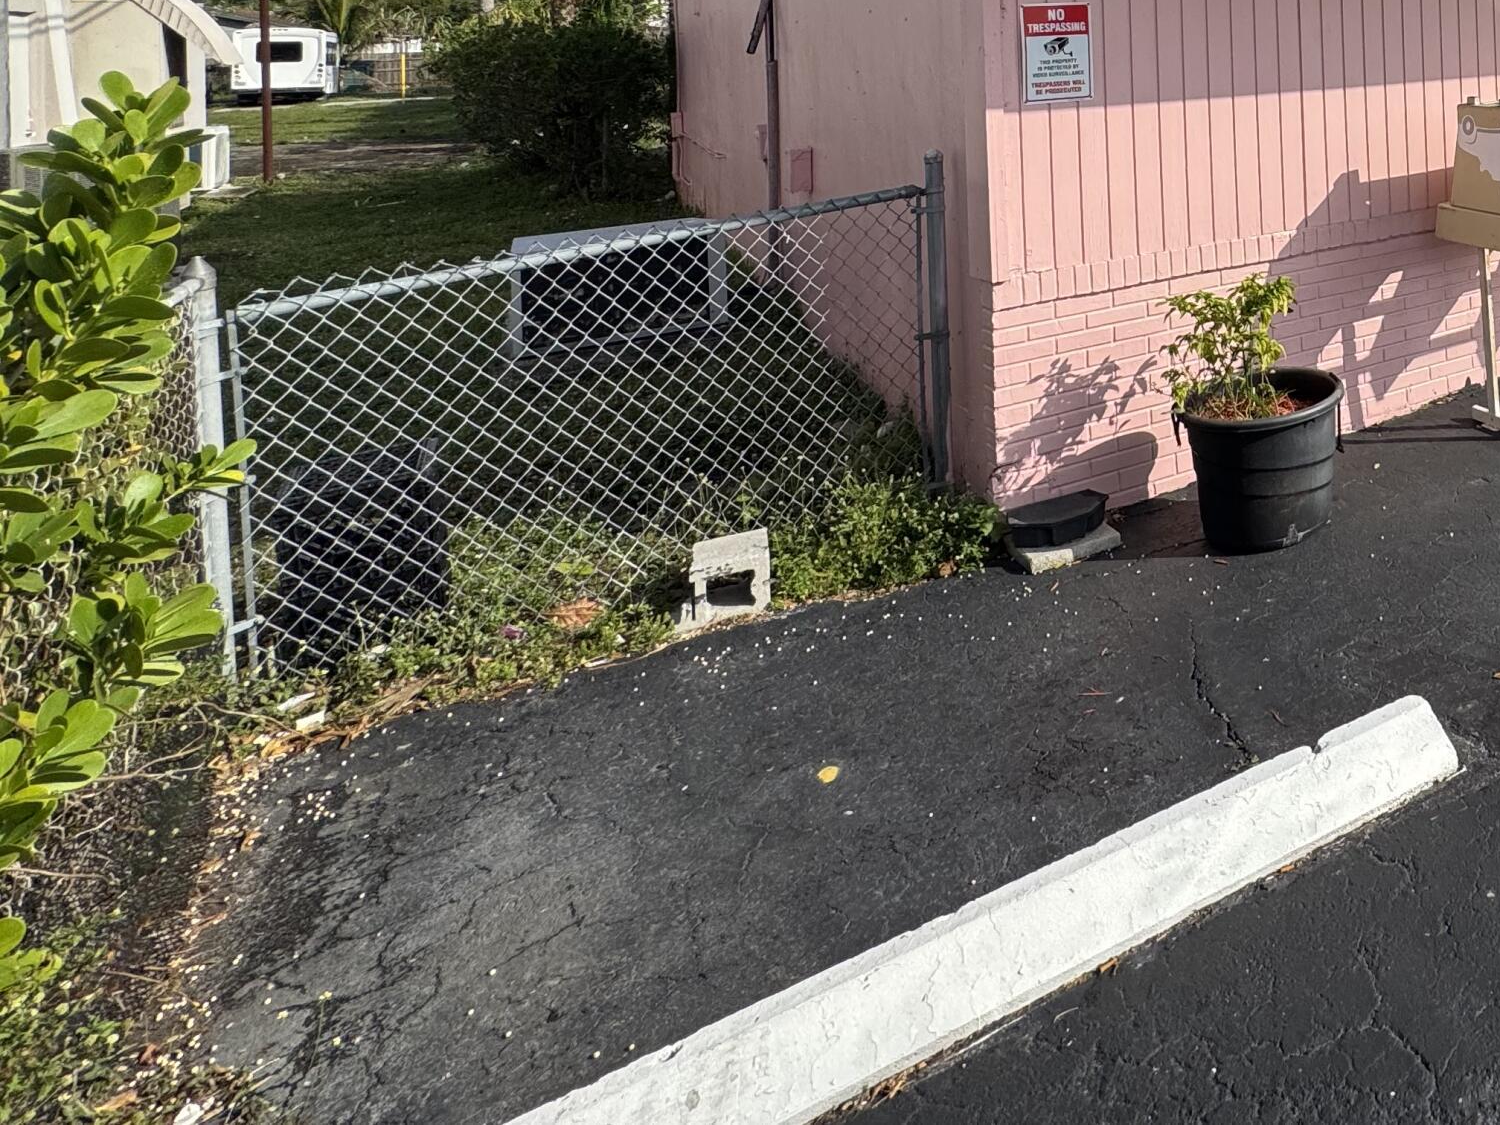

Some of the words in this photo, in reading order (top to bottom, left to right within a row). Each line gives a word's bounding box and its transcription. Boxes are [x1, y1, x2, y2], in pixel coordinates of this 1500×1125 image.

[1047, 9, 1065, 21] NO
[1027, 21, 1086, 34] TRESPASSING
[1031, 80, 1071, 88] TRESPASSERS
